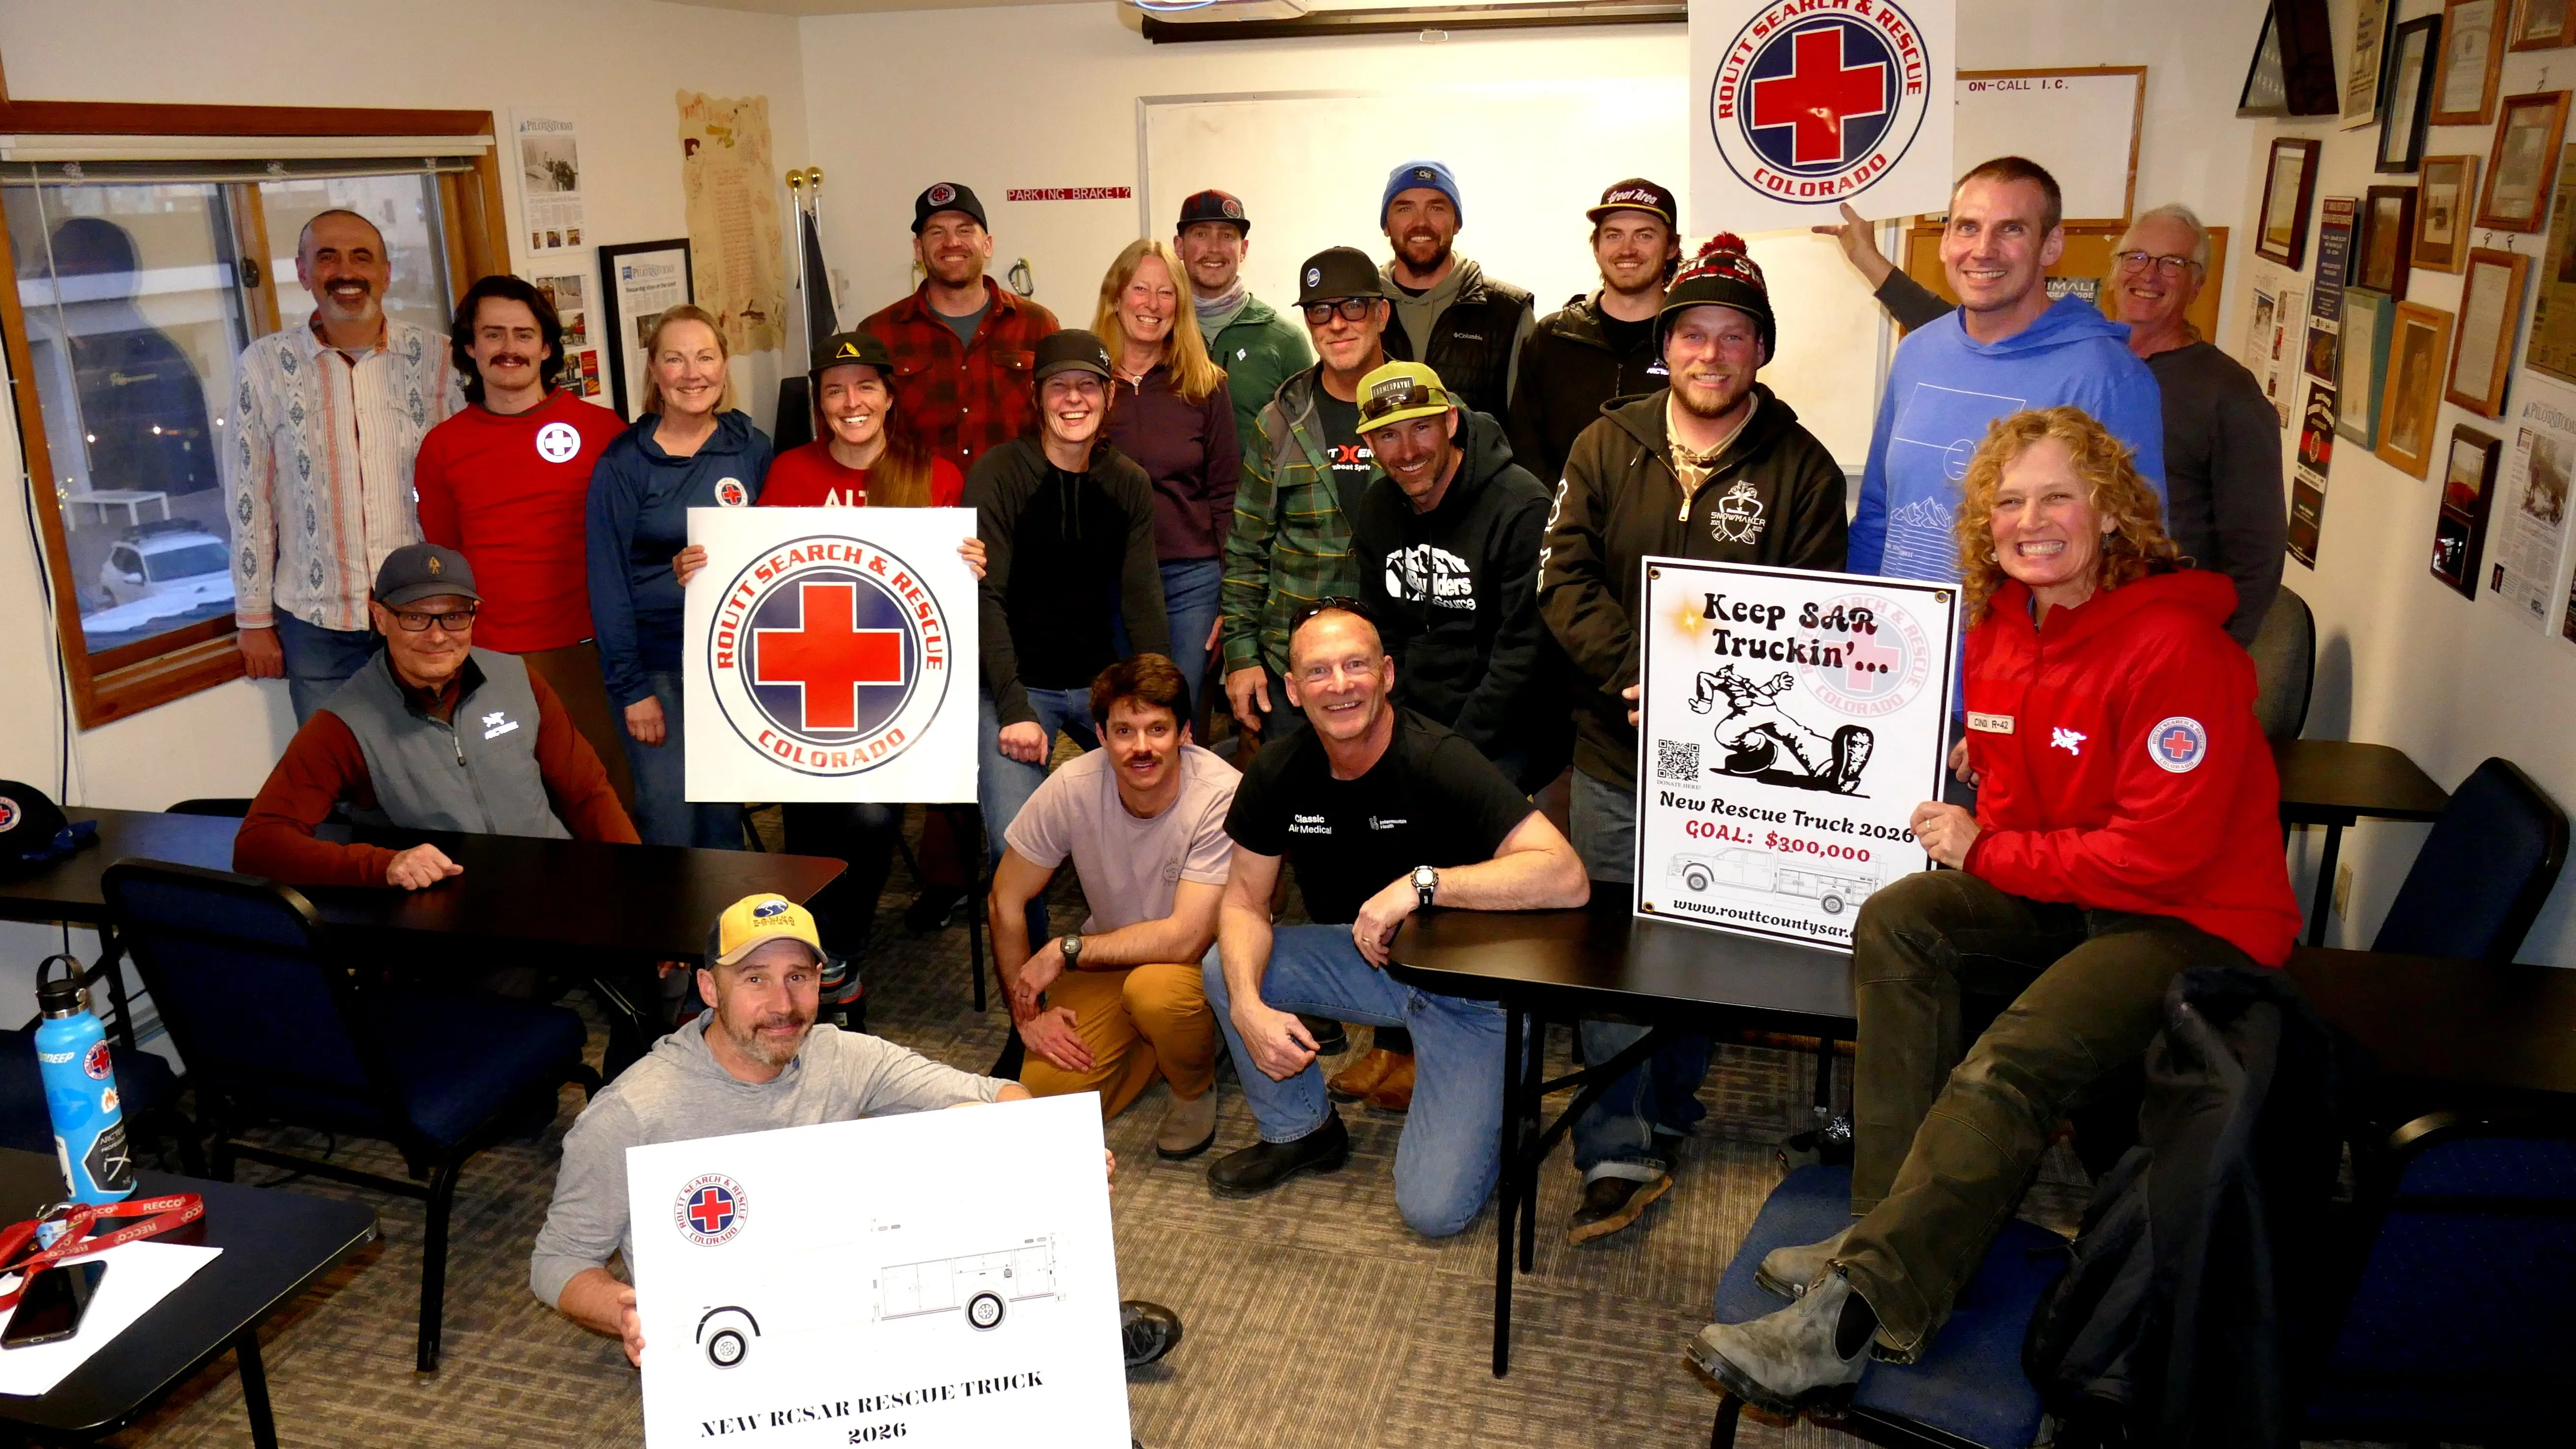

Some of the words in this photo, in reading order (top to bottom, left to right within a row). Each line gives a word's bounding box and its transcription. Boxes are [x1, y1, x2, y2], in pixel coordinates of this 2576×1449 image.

[1719, 38, 1754, 120] ROUTT
[1752, 0, 1848, 39] SEARCH
[1854, 0, 1871, 16] &
[1875, 8, 1922, 96] RESCUE
[1969, 80, 2030, 91] ON-CALL
[2041, 79, 2068, 90] I.C.
[1753, 153, 1888, 197] COLORADO
[1008, 188, 1064, 201] PARKING
[1072, 186, 1130, 199] BRAKE!?
[1607, 190, 1636, 204] Great
[1633, 188, 1658, 204] Area
[2044, 281, 2094, 291] IMALI
[1373, 381, 1411, 397] FARMERPAYNE
[1711, 512, 1765, 527] SNOWMAKER
[718, 580, 756, 669] ROUTT
[755, 544, 863, 585] SEARCH
[868, 554, 889, 577] &
[890, 572, 944, 671] RESCUE
[1703, 593, 1786, 631] Keep
[1799, 602, 1878, 635] SAR
[1903, 624, 1927, 689] RESCUE
[1815, 685, 1905, 715] COLORADO
[1992, 720, 2008, 729] R-42
[758, 727, 907, 769] COLORADO
[1295, 815, 1325, 823] Classic
[1660, 791, 1705, 812] New
[1711, 798, 1787, 823] Rescue
[1792, 810, 1854, 834] Truck
[1859, 823, 1915, 843] 2026
[1289, 824, 1300, 833] Air
[1300, 825, 1332, 834] Medical
[1686, 820, 1753, 844] GOAL:
[1765, 831, 1870, 862] $300,000
[143, 1199, 182, 1211] RECCO
[676, 1196, 687, 1229] ROUTT
[684, 1176, 721, 1194] SEARCH
[732, 1185, 746, 1221] RESCUE
[119, 1222, 157, 1242] RECCO
[689, 1227, 738, 1244] COLORADO
[701, 1414, 761, 1437] NEW
[770, 1401, 850, 1426] RCSAR
[857, 1384, 956, 1414] RESCUE
[961, 1371, 1043, 1397] TRUCK
[848, 1422, 907, 1445] 2026
